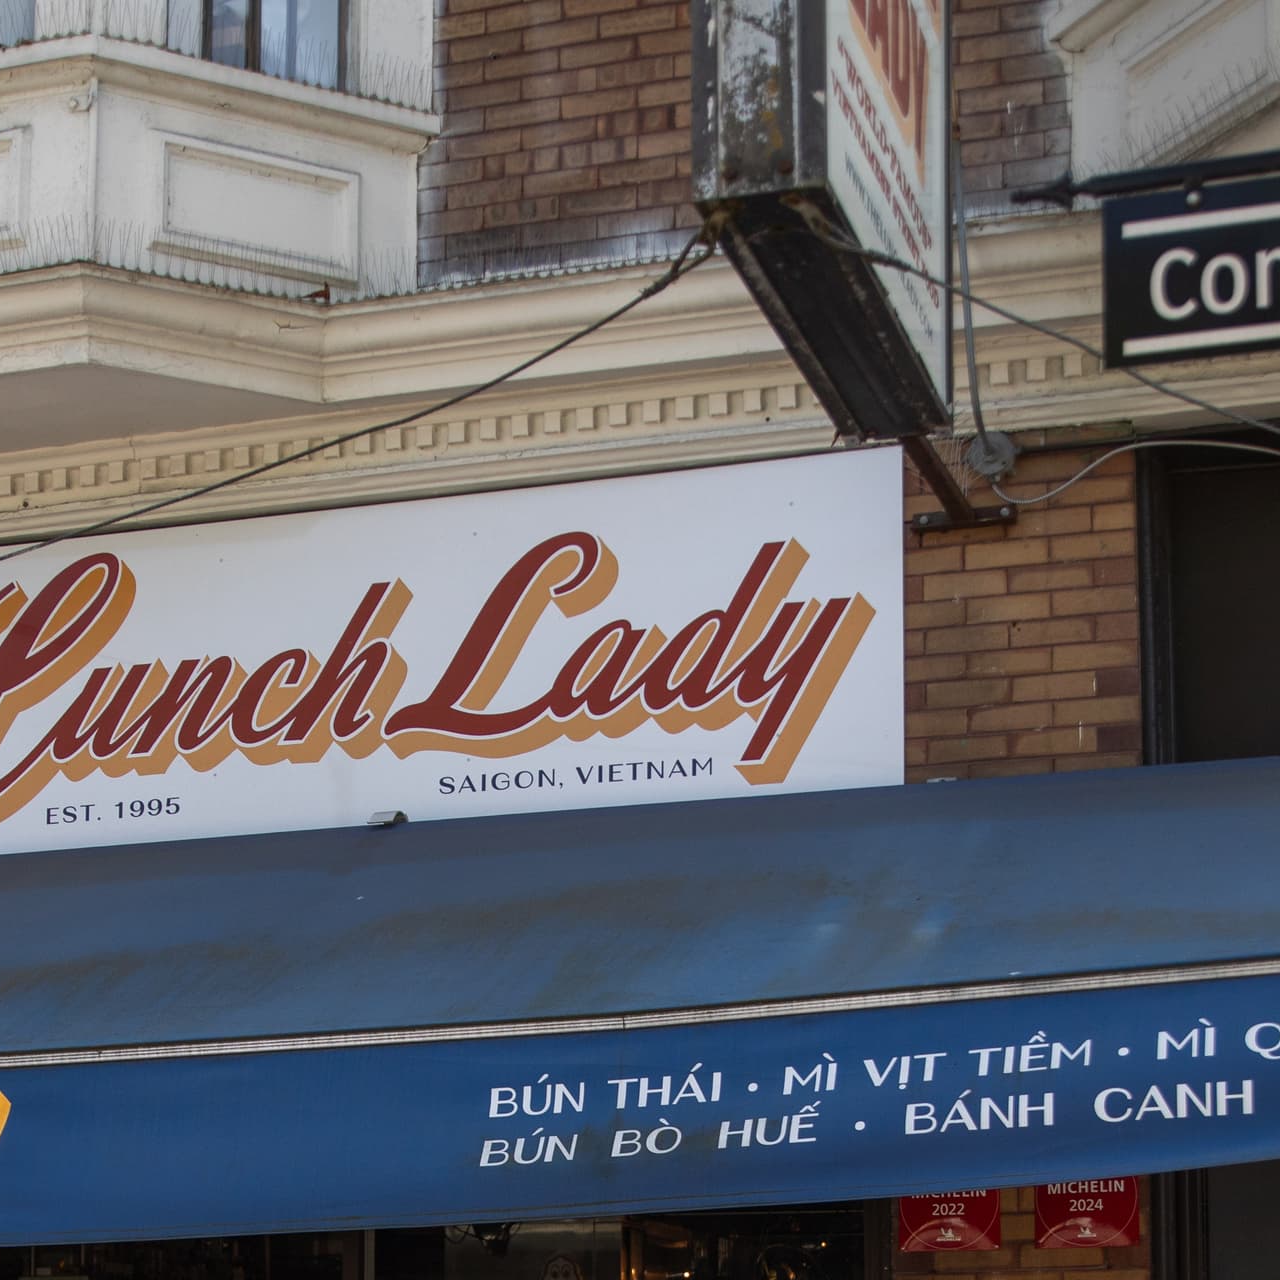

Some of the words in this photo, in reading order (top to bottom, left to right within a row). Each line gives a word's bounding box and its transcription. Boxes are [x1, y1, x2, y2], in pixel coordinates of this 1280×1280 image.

[382, 530, 878, 786] Lady
[437, 768, 567, 796] SAIGON,
[575, 757, 716, 785] VIETNAM
[44, 798, 104, 827] EST.
[112, 795, 183, 821] 1995
[488, 1073, 587, 1119] BÚN
[607, 1062, 723, 1109] THÁI
[782, 1052, 839, 1097] MÌ
[862, 1051, 949, 1090] VỊT
[967, 1030, 1093, 1078] TIỀM
[1155, 1016, 1217, 1061] MÌ
[478, 1126, 579, 1168] BÚN
[609, 1117, 683, 1158] BÒ
[716, 1101, 824, 1151] HUẾ
[903, 1088, 1056, 1137] BÁNH
[1092, 1079, 1256, 1123] CANH
[1046, 1179, 1125, 1196] MICHELIN
[931, 1202, 966, 1217] 2022
[1068, 1198, 1104, 1213] 2024
